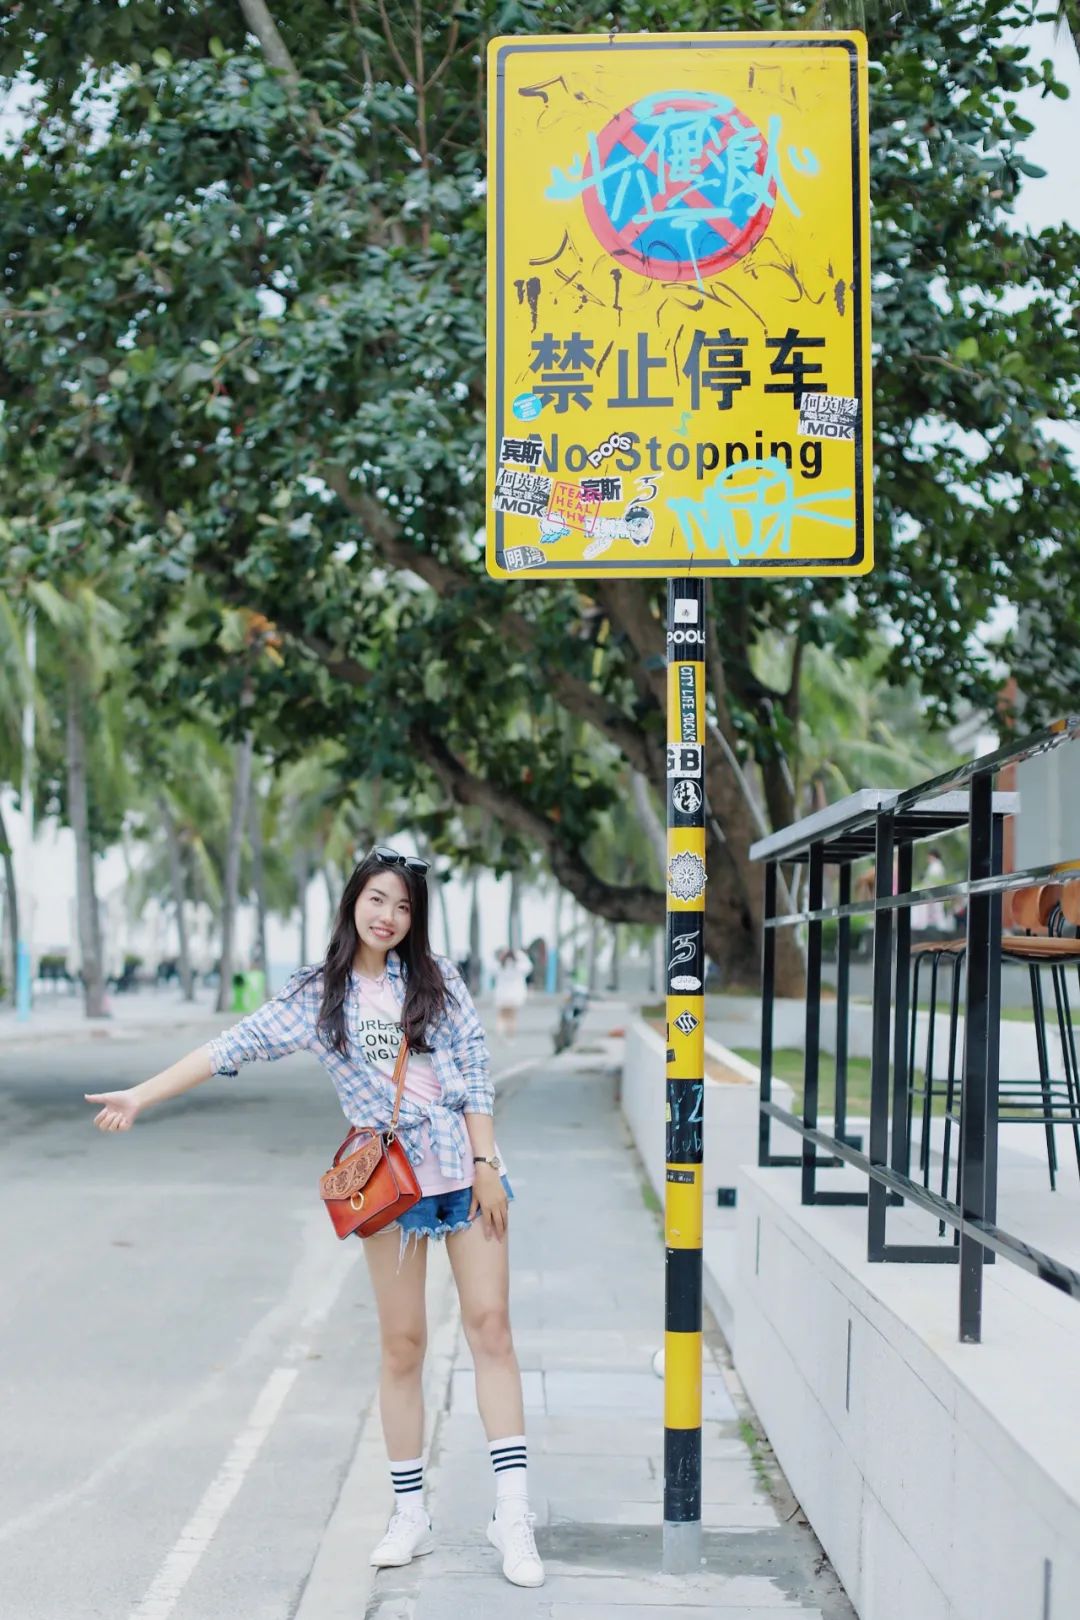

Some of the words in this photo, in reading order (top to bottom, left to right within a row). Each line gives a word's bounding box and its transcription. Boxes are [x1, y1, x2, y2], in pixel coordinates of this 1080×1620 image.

[530, 328, 828, 413] 禁止停车
[806, 422, 852, 439] MOK
[501, 439, 543, 465] 宾斯
[526, 432, 588, 473] No
[615, 431, 823, 480] Stopping
[500, 498, 543, 518] MOK
[680, 667, 694, 687] CITY
[681, 689, 694, 710] LIFE
[682, 712, 697, 742] SUCKS
